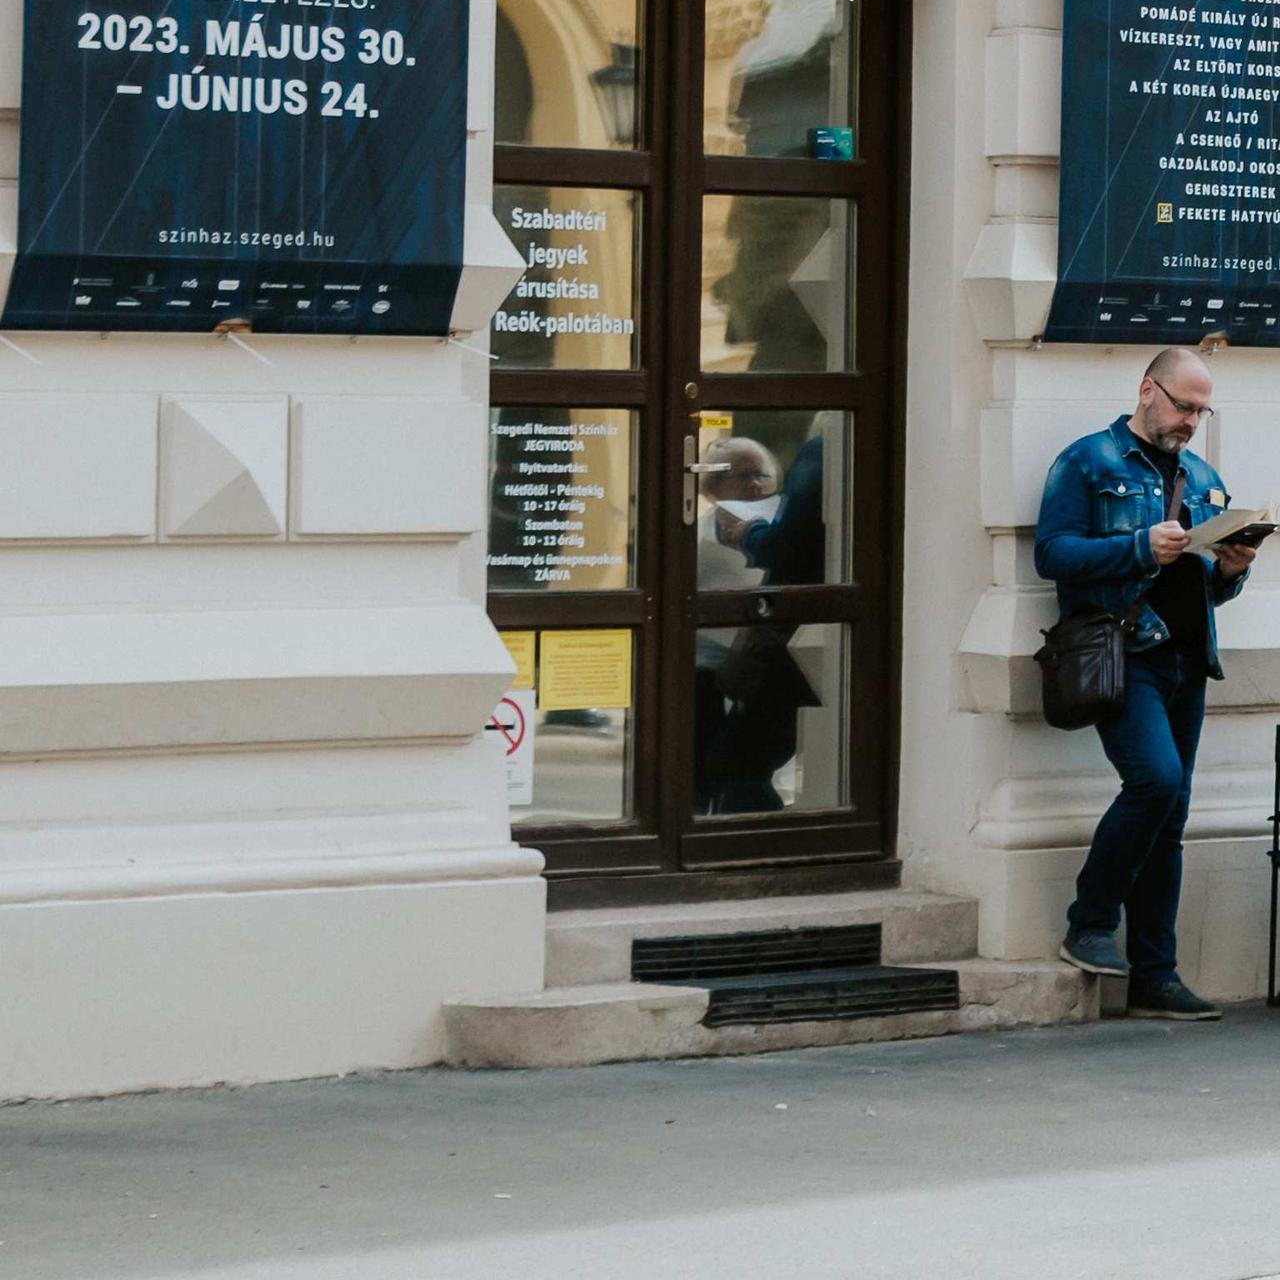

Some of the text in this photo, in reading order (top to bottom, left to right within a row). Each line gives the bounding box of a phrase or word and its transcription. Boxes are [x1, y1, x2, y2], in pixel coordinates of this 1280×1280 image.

[1141, 6, 1196, 22] POMÁDÉ
[1202, 9, 1246, 26] KIRÁLY
[1252, 12, 1268, 28] ÚJ
[77, 13, 417, 66] 2023. MÁJUS 30.
[1120, 31, 1204, 50] VÍZKERESZT,
[1210, 37, 1242, 50] VAGY
[1248, 40, 1279, 53] AMIT
[1174, 59, 1191, 71] AZ
[1196, 60, 1242, 75] ELTÖRT
[156, 66, 308, 114] JÚNIUS
[320, 83, 379, 119] 24.
[1130, 81, 1137, 93] A
[1143, 80, 1167, 94] KÉT
[1173, 83, 1216, 97] KOREA
[1205, 110, 1259, 125] AZ AJTÓ
[1176, 133, 1185, 145] A
[1191, 133, 1241, 148] CSENGŐ
[1159, 156, 1244, 174] GAZDÁLKODJ
[1185, 183, 1276, 199] GENGSZTEREK
[512, 208, 606, 231] Szabadtéri
[1179, 207, 1280, 224] FEKETE HATTYÚ
[528, 242, 588, 268] jegyek
[517, 276, 598, 298] árusítása
[492, 423, 532, 438] Szegedi
[535, 424, 577, 435] Nemzeti
[524, 440, 584, 451] JEGYIRODA
[524, 501, 535, 511] 10
[544, 501, 556, 511] 17
[523, 536, 535, 545] 10
[544, 536, 556, 546] 12
